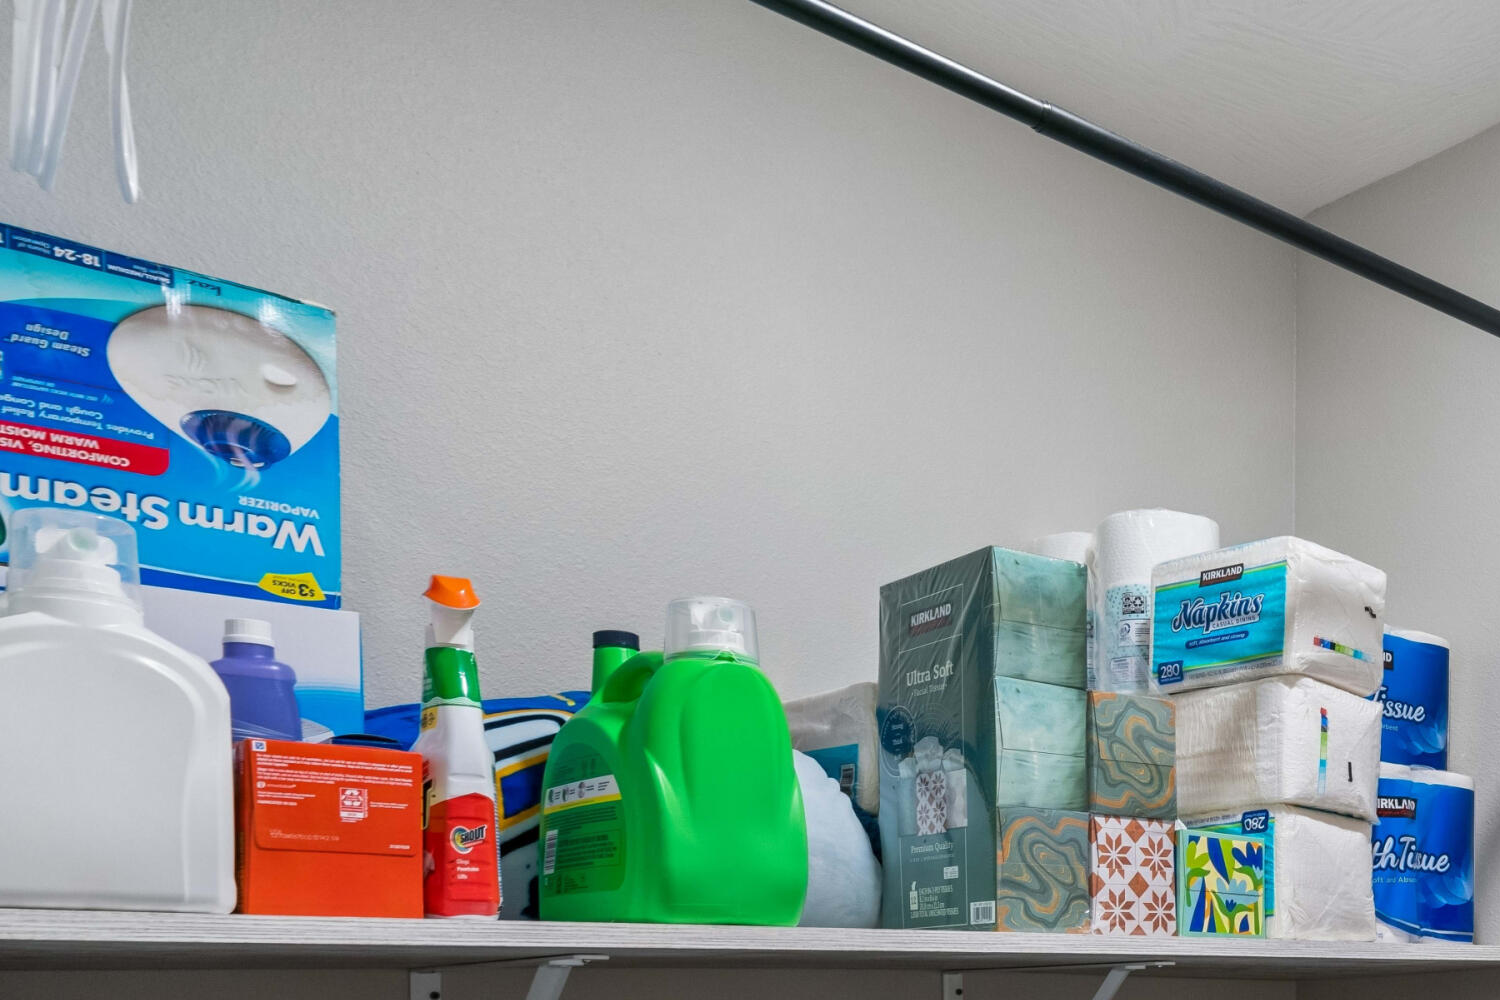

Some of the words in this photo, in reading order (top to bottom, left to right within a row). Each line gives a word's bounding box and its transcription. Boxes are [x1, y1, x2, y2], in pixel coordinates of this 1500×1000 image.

[53, 245, 101, 267] 18-24
[25, 323, 69, 341] Design
[52, 341, 91, 357] Steam
[1, 405, 35, 418] Relief
[39, 402, 63, 411] and
[66, 406, 103, 420] Cough
[39, 410, 103, 430] Temporary
[0, 424, 45, 439] MOIST
[106, 423, 154, 440] Provides
[0, 437, 24, 450] VIS
[51, 433, 99, 449] WARM
[28, 440, 130, 467] COMFORTING,
[0, 472, 170, 530] Steam
[239, 495, 320, 520] VAPORIZER
[179, 501, 325, 557] Warm
[1202, 566, 1242, 581] KIRKLAND
[298, 583, 315, 598] $3
[911, 603, 952, 627] KIRKLAND
[1172, 592, 1264, 634] Napkins
[906, 670, 931, 687] Ultra
[934, 660, 954, 680] Soft
[1160, 663, 1179, 678] 280
[1244, 816, 1265, 831] 280
[460, 825, 486, 843] SHOUT
